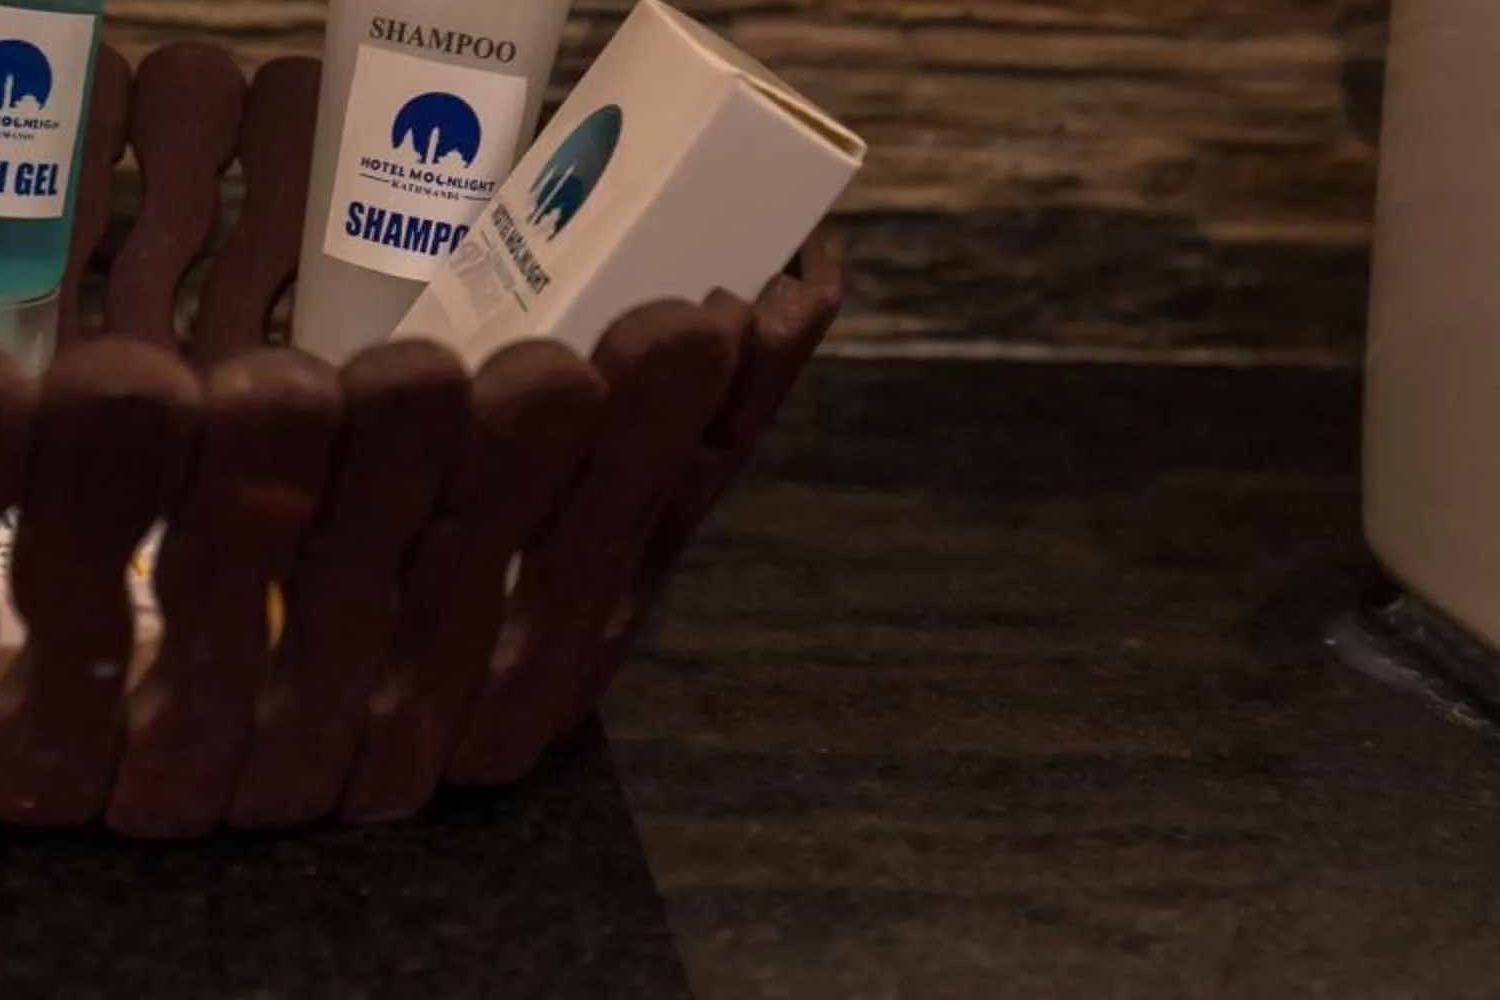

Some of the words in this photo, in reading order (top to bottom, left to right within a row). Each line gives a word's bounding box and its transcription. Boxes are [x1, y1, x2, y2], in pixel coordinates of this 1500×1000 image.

[368, 16, 517, 64] SHAMPOO
[13, 162, 60, 196] GEL
[360, 156, 405, 177] HOTEL
